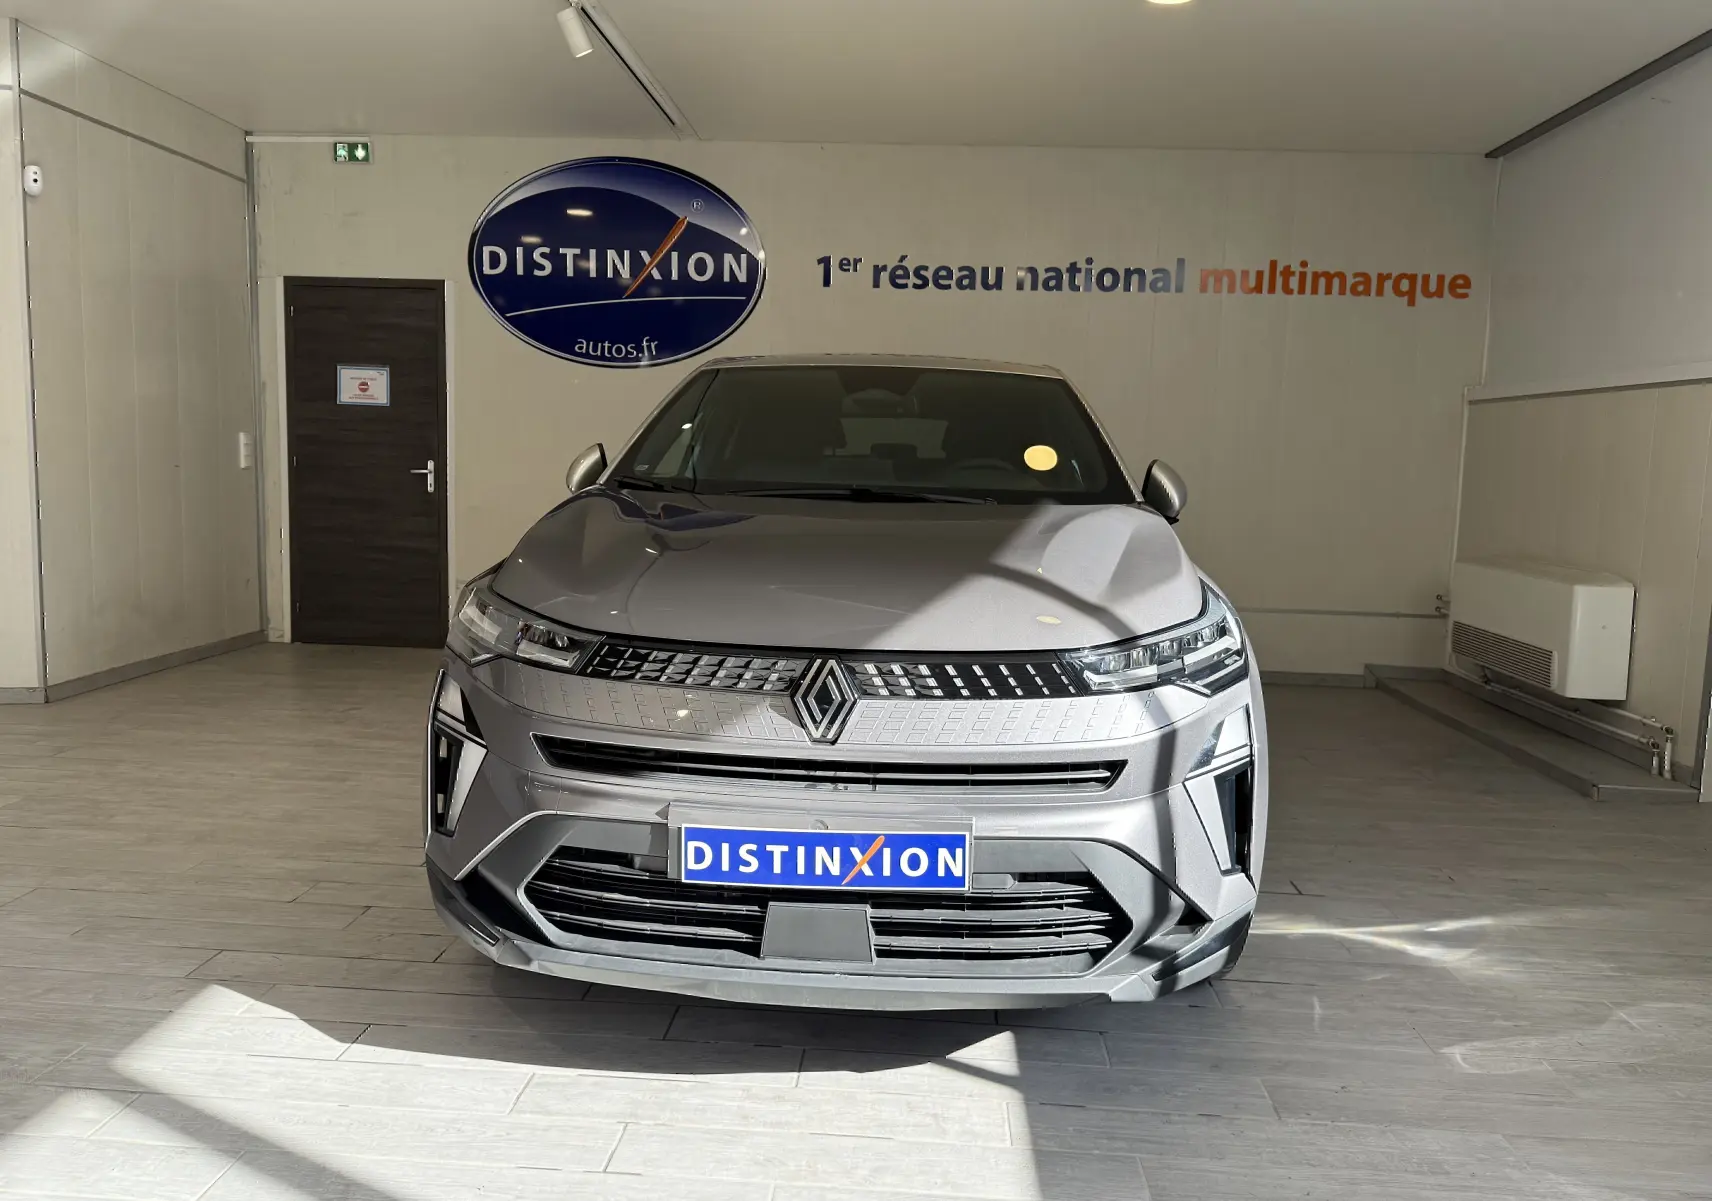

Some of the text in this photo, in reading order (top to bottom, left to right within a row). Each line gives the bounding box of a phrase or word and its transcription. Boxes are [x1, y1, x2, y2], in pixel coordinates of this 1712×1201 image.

[482, 245, 748, 283] DISTINXION
[872, 255, 1004, 291] réseau
[1016, 257, 1186, 293] national
[1200, 259, 1472, 307] multimarque
[574, 336, 659, 359] autos.fr
[686, 839, 963, 878] DISTINXION
